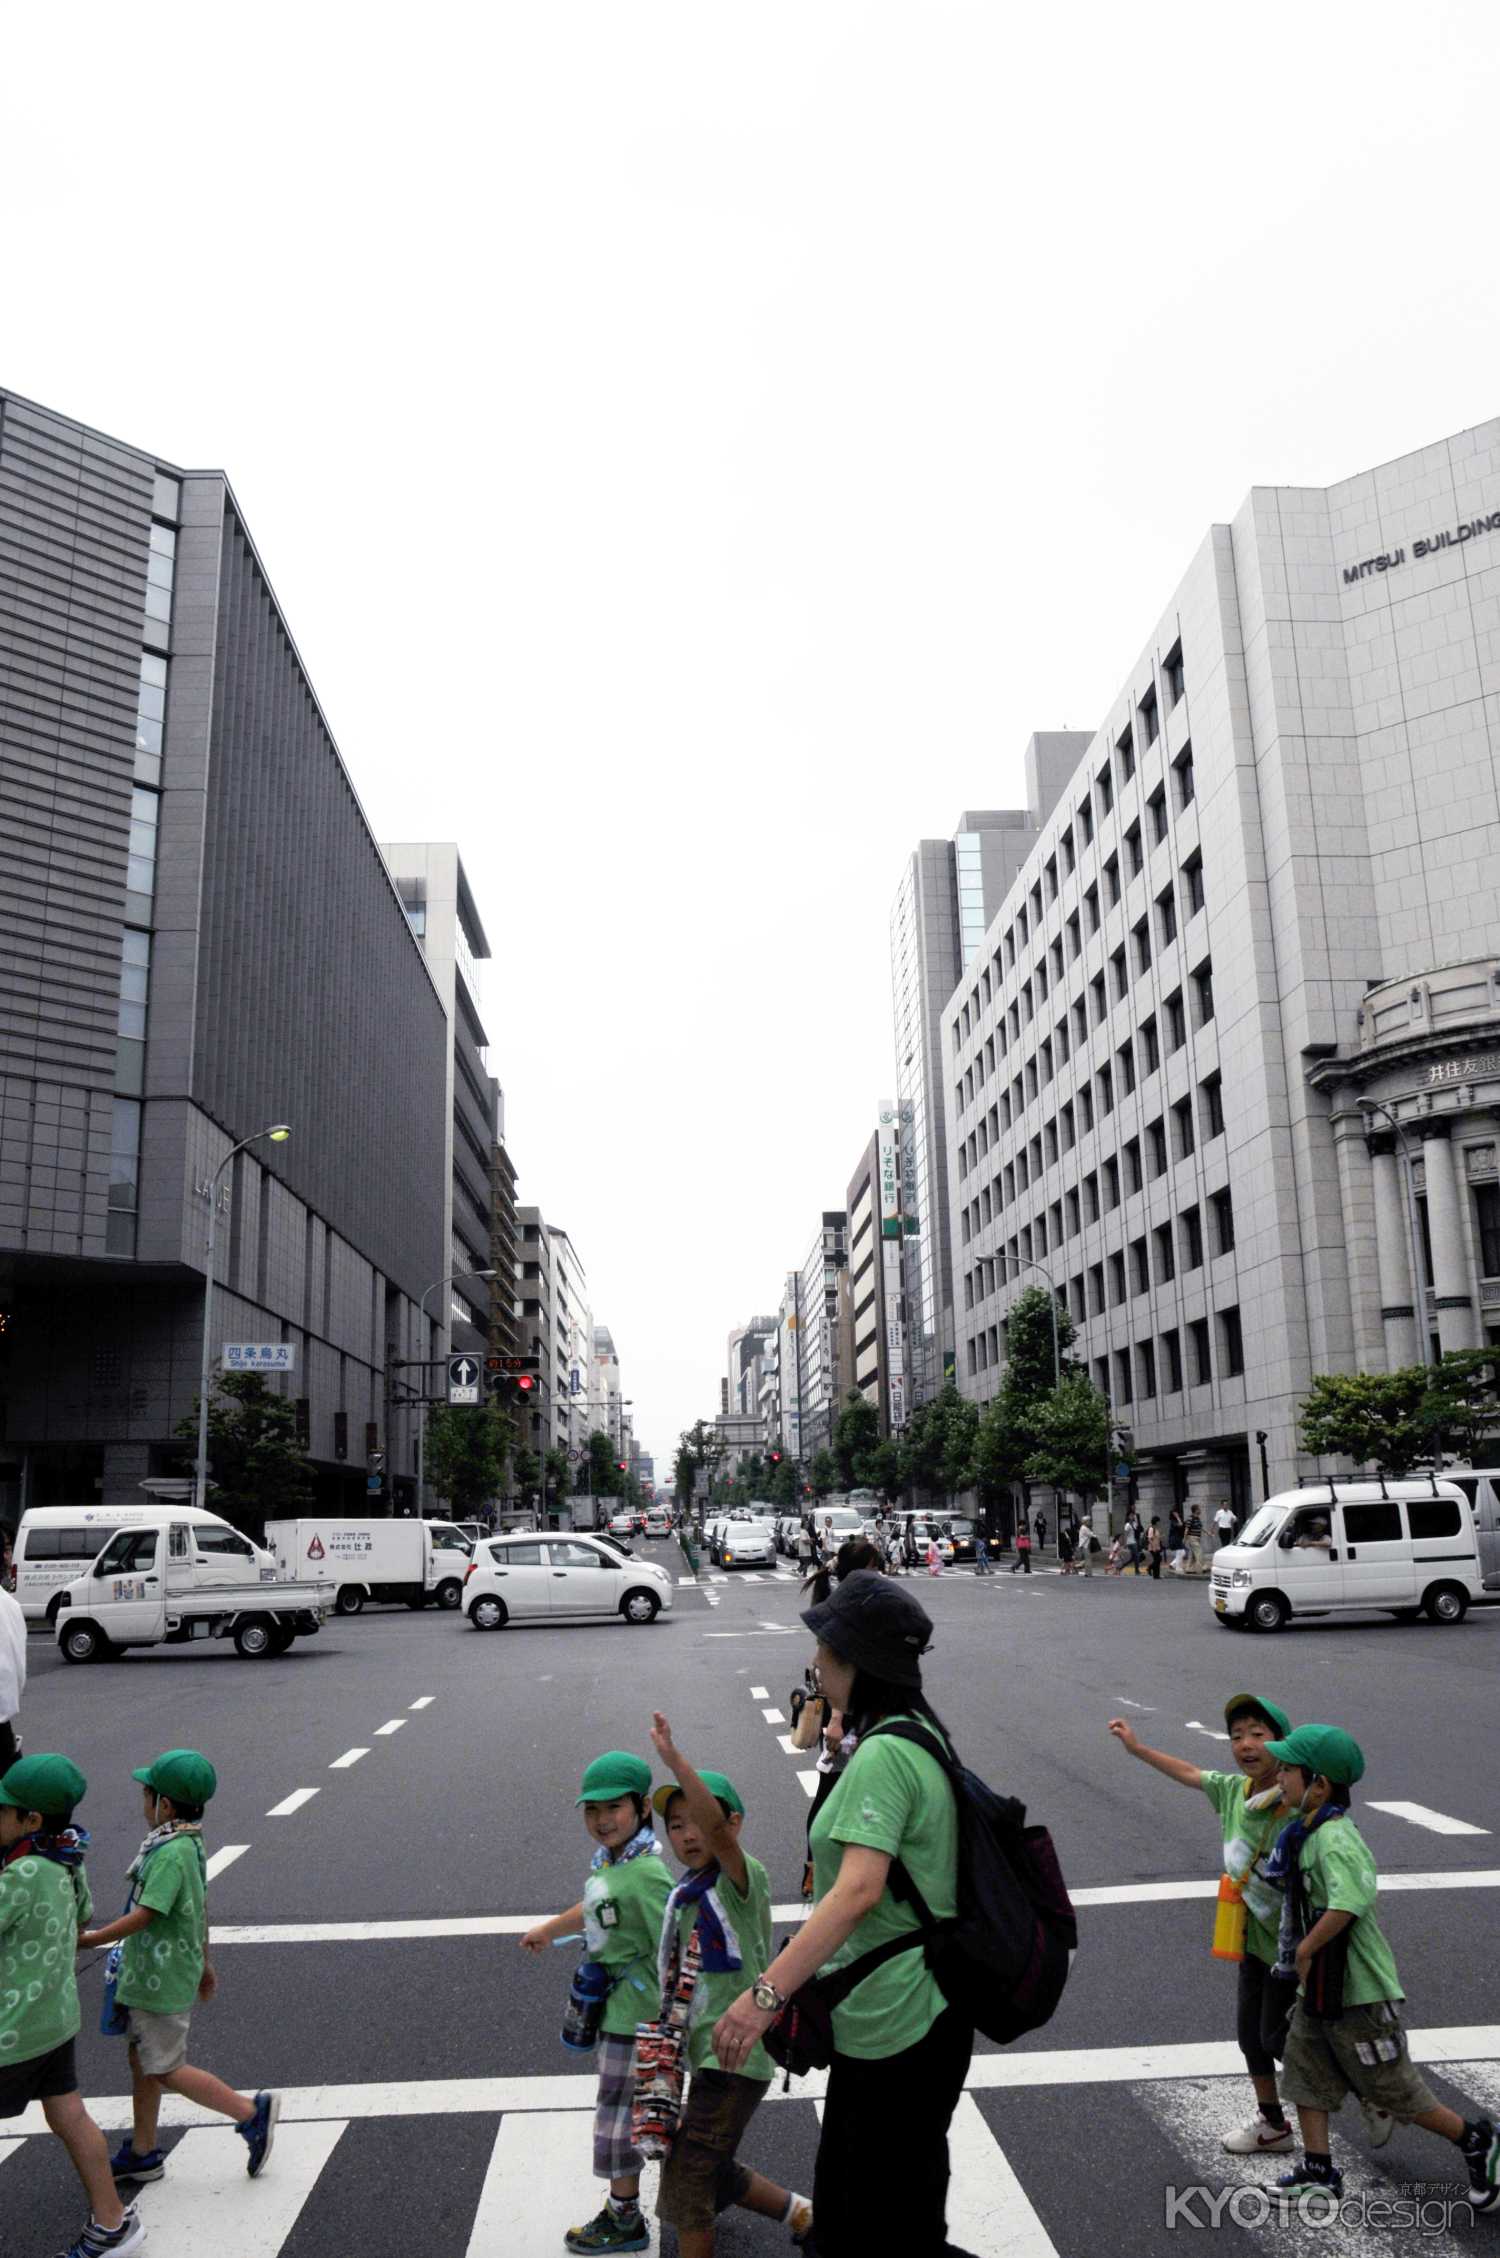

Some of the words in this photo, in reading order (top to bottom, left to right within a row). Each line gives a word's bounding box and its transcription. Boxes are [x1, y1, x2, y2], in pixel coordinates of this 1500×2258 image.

[1343, 548, 1405, 584] MITSUI
[1412, 511, 1500, 558] BUILDING
[883, 1145, 897, 1204] りそな銀行
[228, 1346, 289, 1361] 四条烏丸
